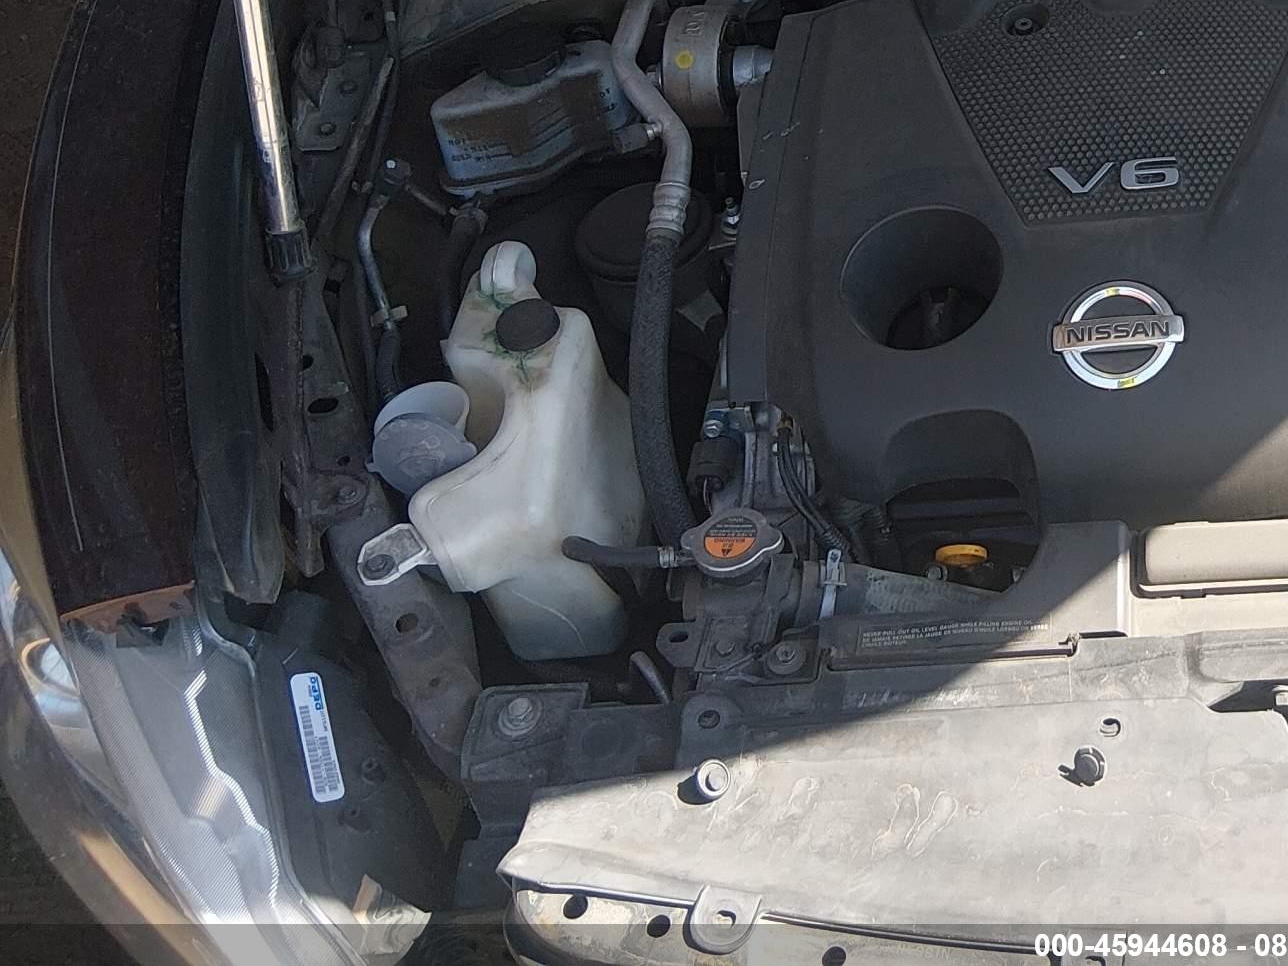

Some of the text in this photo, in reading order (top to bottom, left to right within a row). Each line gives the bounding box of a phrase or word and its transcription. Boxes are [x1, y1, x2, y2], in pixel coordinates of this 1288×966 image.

[1047, 156, 1182, 194] V6
[1066, 320, 1170, 345] NISSAN
[310, 676, 324, 710] DEPO
